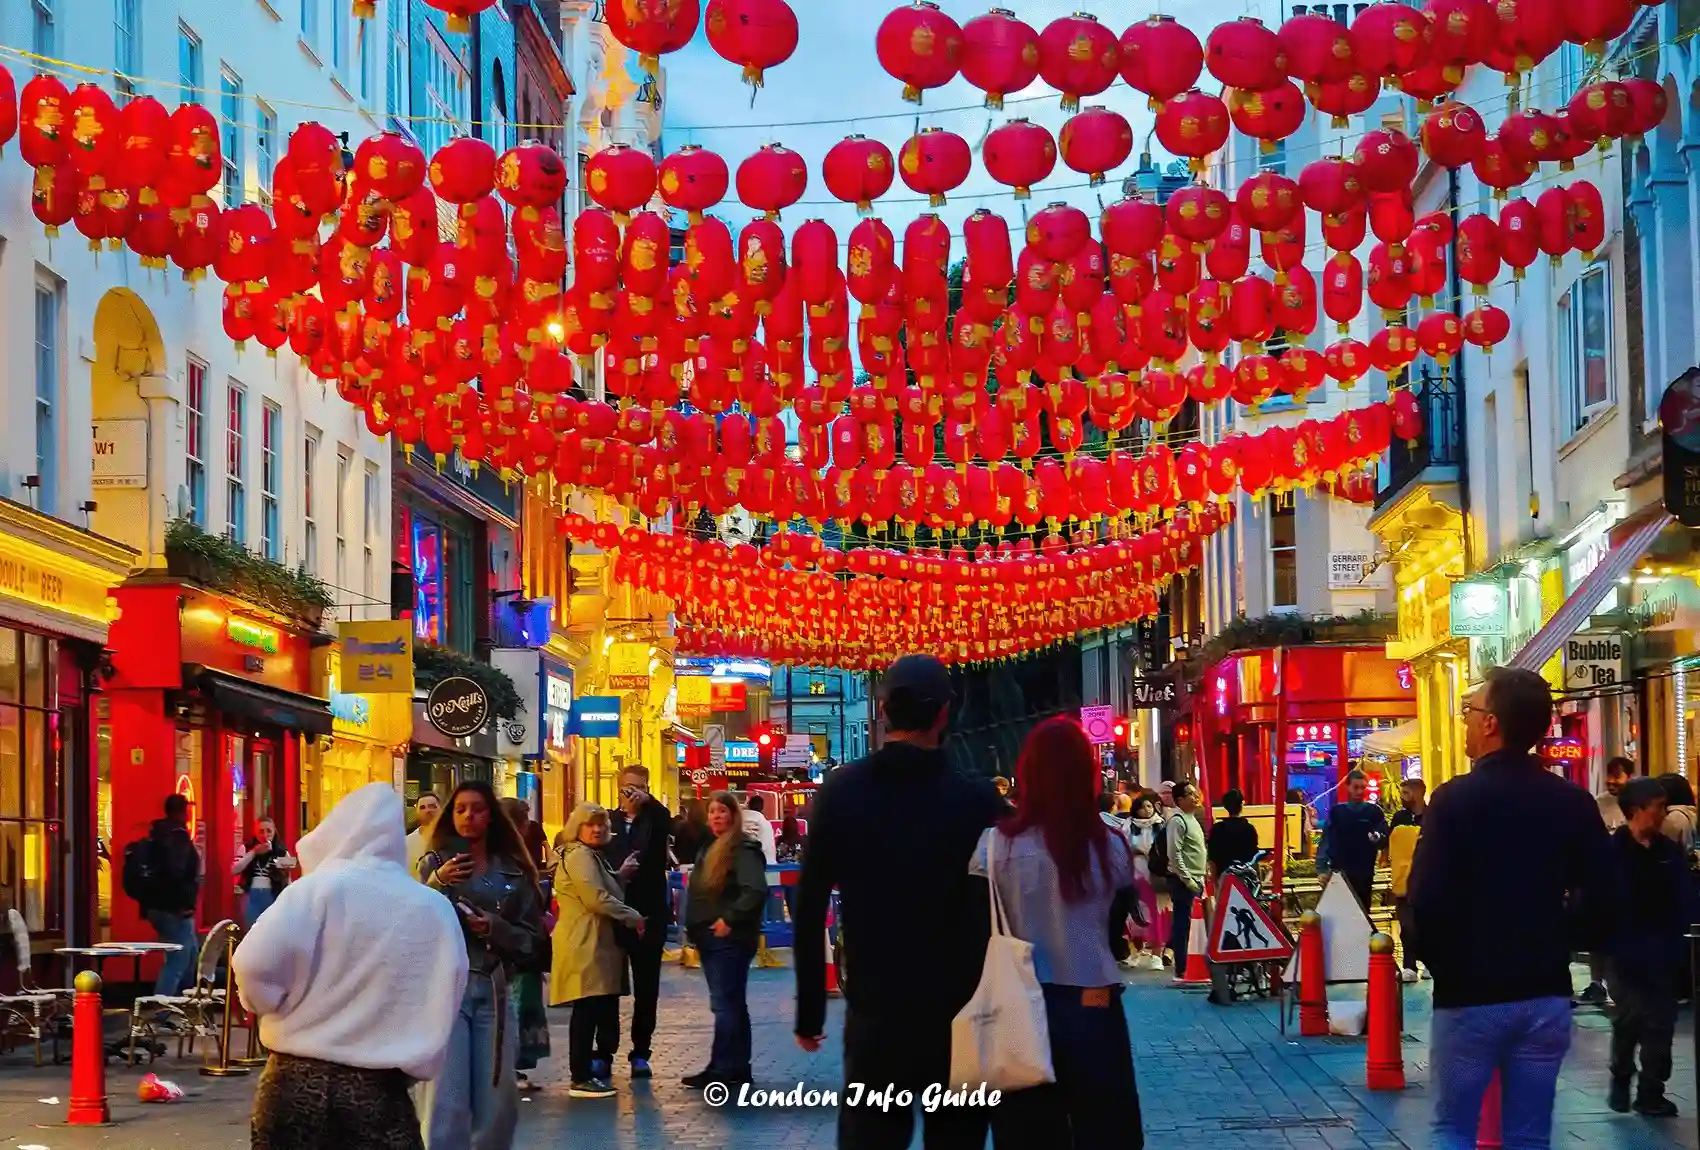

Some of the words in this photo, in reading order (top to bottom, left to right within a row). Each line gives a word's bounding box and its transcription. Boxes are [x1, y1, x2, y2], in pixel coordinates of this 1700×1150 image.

[95, 442, 114, 454] W1
[1332, 563, 1360, 571] STREET
[41, 571, 62, 603] BEER
[1568, 640, 1621, 661] Bubble
[610, 676, 635, 688] Wong
[1589, 664, 1616, 685] Tea
[1136, 683, 1173, 702] Viet
[431, 692, 483, 717] O'Neill's
[1550, 746, 1581, 758] OPEN
[693, 772, 706, 780] 20
